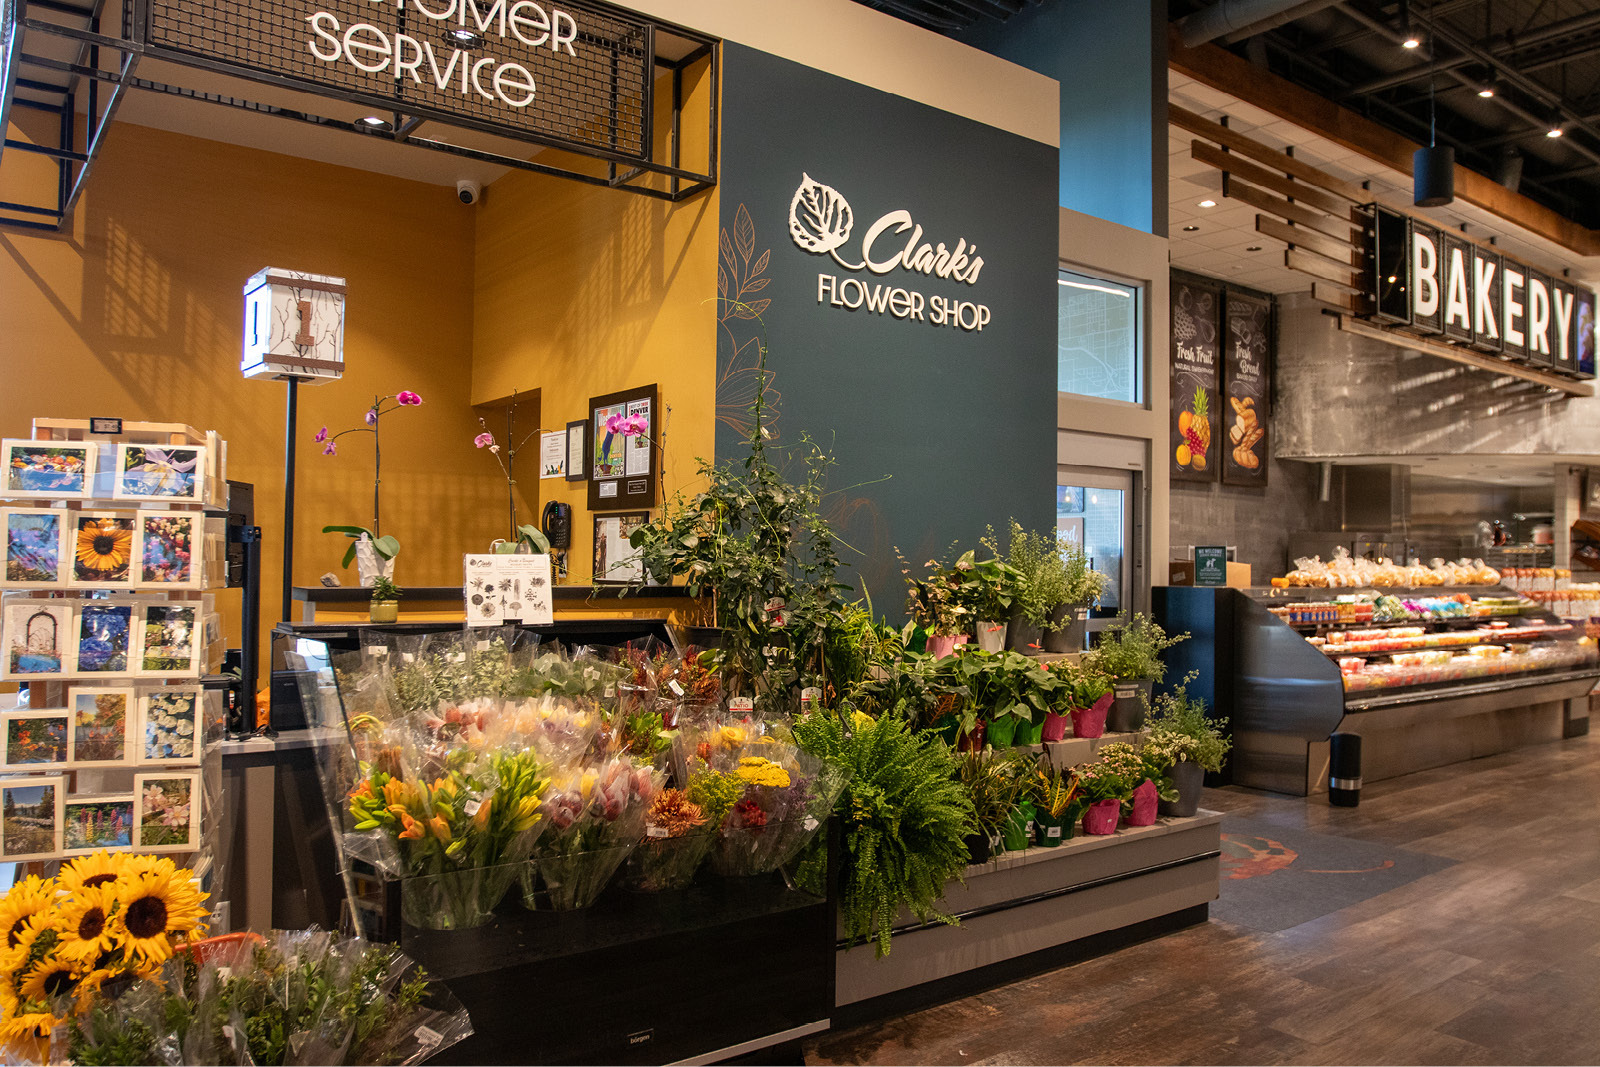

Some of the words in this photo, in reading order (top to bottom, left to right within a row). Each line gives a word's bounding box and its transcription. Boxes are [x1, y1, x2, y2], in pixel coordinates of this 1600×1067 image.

[862, 209, 984, 284] Clark's
[929, 295, 991, 331] SHOP
[1413, 232, 1574, 360] BAKERY
[1176, 341, 1195, 362] Fresh
[1196, 345, 1214, 365] Fruit
[1235, 340, 1252, 361] Fresh
